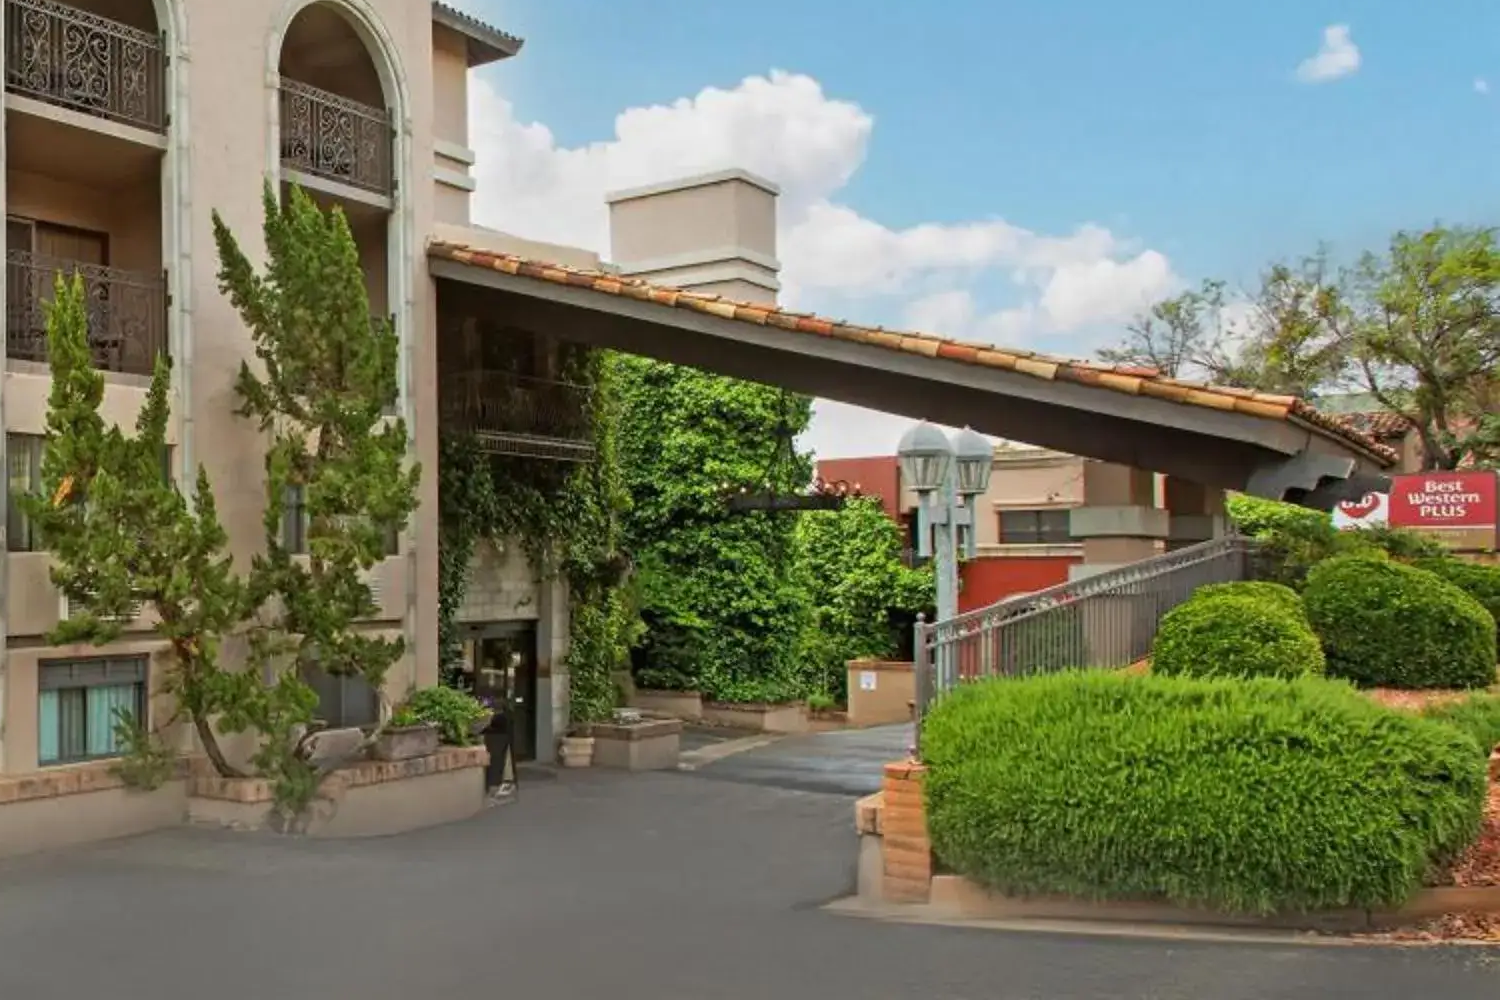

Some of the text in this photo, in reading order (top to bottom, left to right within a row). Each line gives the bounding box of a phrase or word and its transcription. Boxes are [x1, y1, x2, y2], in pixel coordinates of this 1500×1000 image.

[1424, 480, 1464, 493] Best
[1407, 492, 1481, 505] Western
[1419, 505, 1466, 517] PLUS
